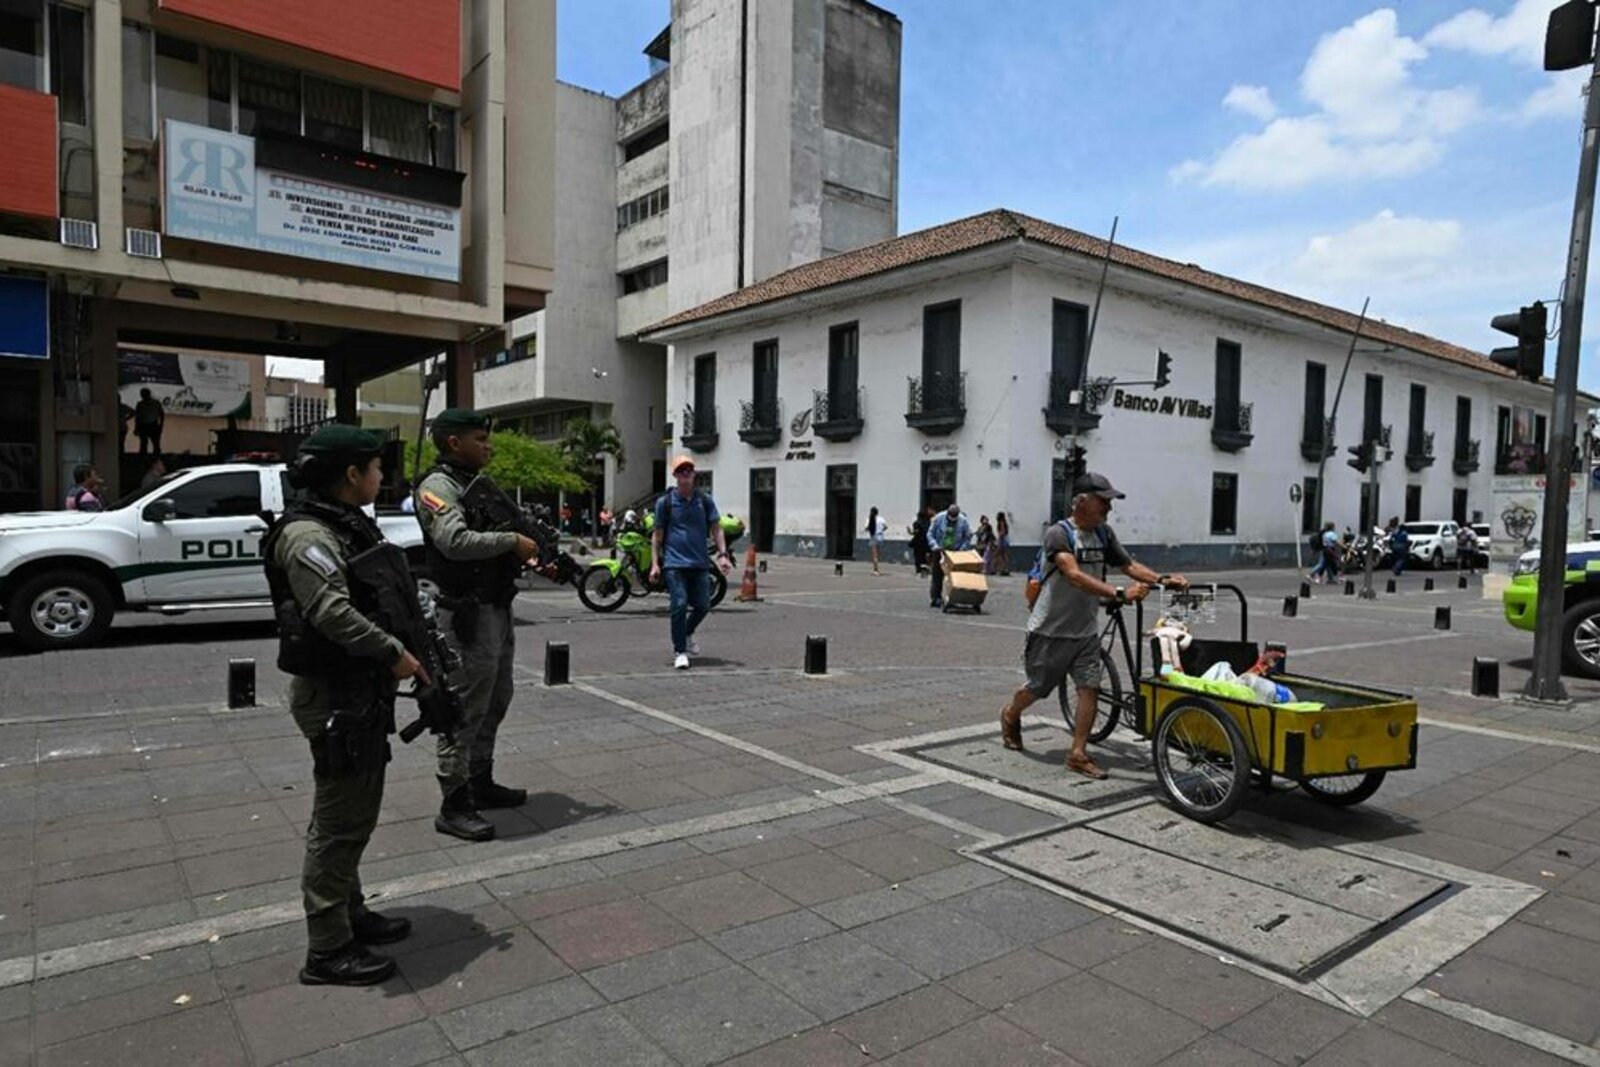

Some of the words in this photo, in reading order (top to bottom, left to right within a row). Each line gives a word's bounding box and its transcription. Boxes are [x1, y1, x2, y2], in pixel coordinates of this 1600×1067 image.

[183, 184, 209, 196] ROJAS
[219, 192, 243, 202] ROJAS
[285, 193, 344, 211] INVERSIONES
[305, 206, 377, 227] ARRENDAMIENTOS
[379, 220, 435, 237] GARANTIZADOS
[316, 218, 342, 230] VENTA
[344, 223, 355, 232] DE
[370, 237, 397, 248] ROJAS
[1113, 388, 1159, 413] Banco
[1159, 396, 1178, 416] AV
[1178, 398, 1212, 419] Villas
